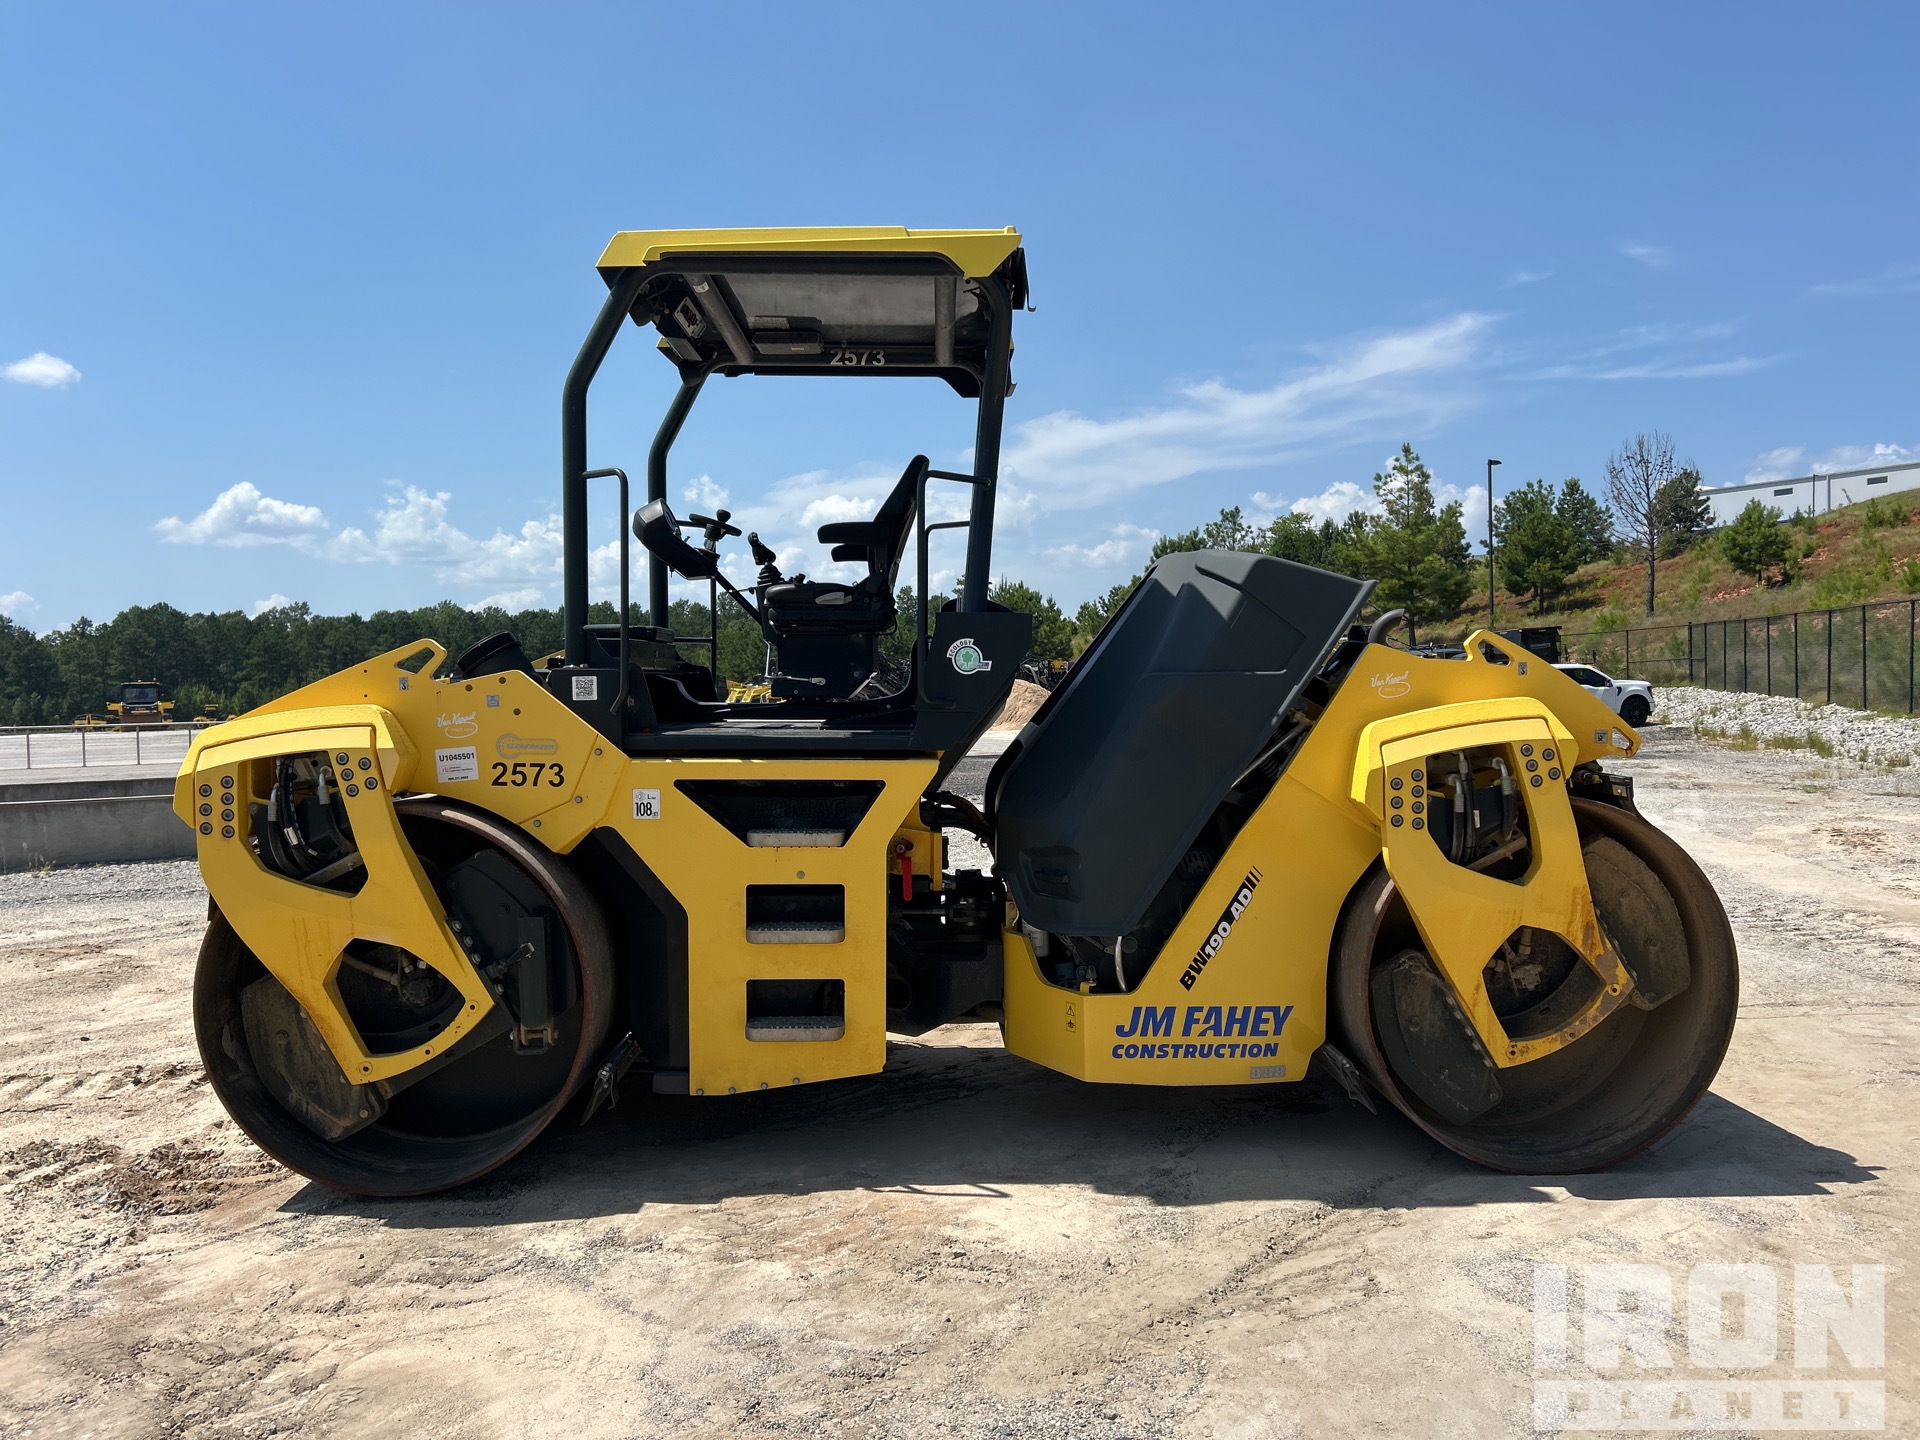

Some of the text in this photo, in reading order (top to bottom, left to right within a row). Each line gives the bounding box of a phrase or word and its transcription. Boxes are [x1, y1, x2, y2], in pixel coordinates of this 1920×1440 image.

[830, 349, 886, 366] 2573
[948, 639, 972, 657] ECOLOGY
[1371, 673, 1385, 688] Van
[436, 713, 451, 728] Van
[438, 752, 475, 762] U1045501
[491, 762, 565, 787] 2573
[635, 801, 652, 817] 108
[753, 799, 847, 819] BOMAG
[1115, 1005, 1294, 1038] JM FAHEY
[1111, 1042, 1279, 1060] CONSTRUCTION
